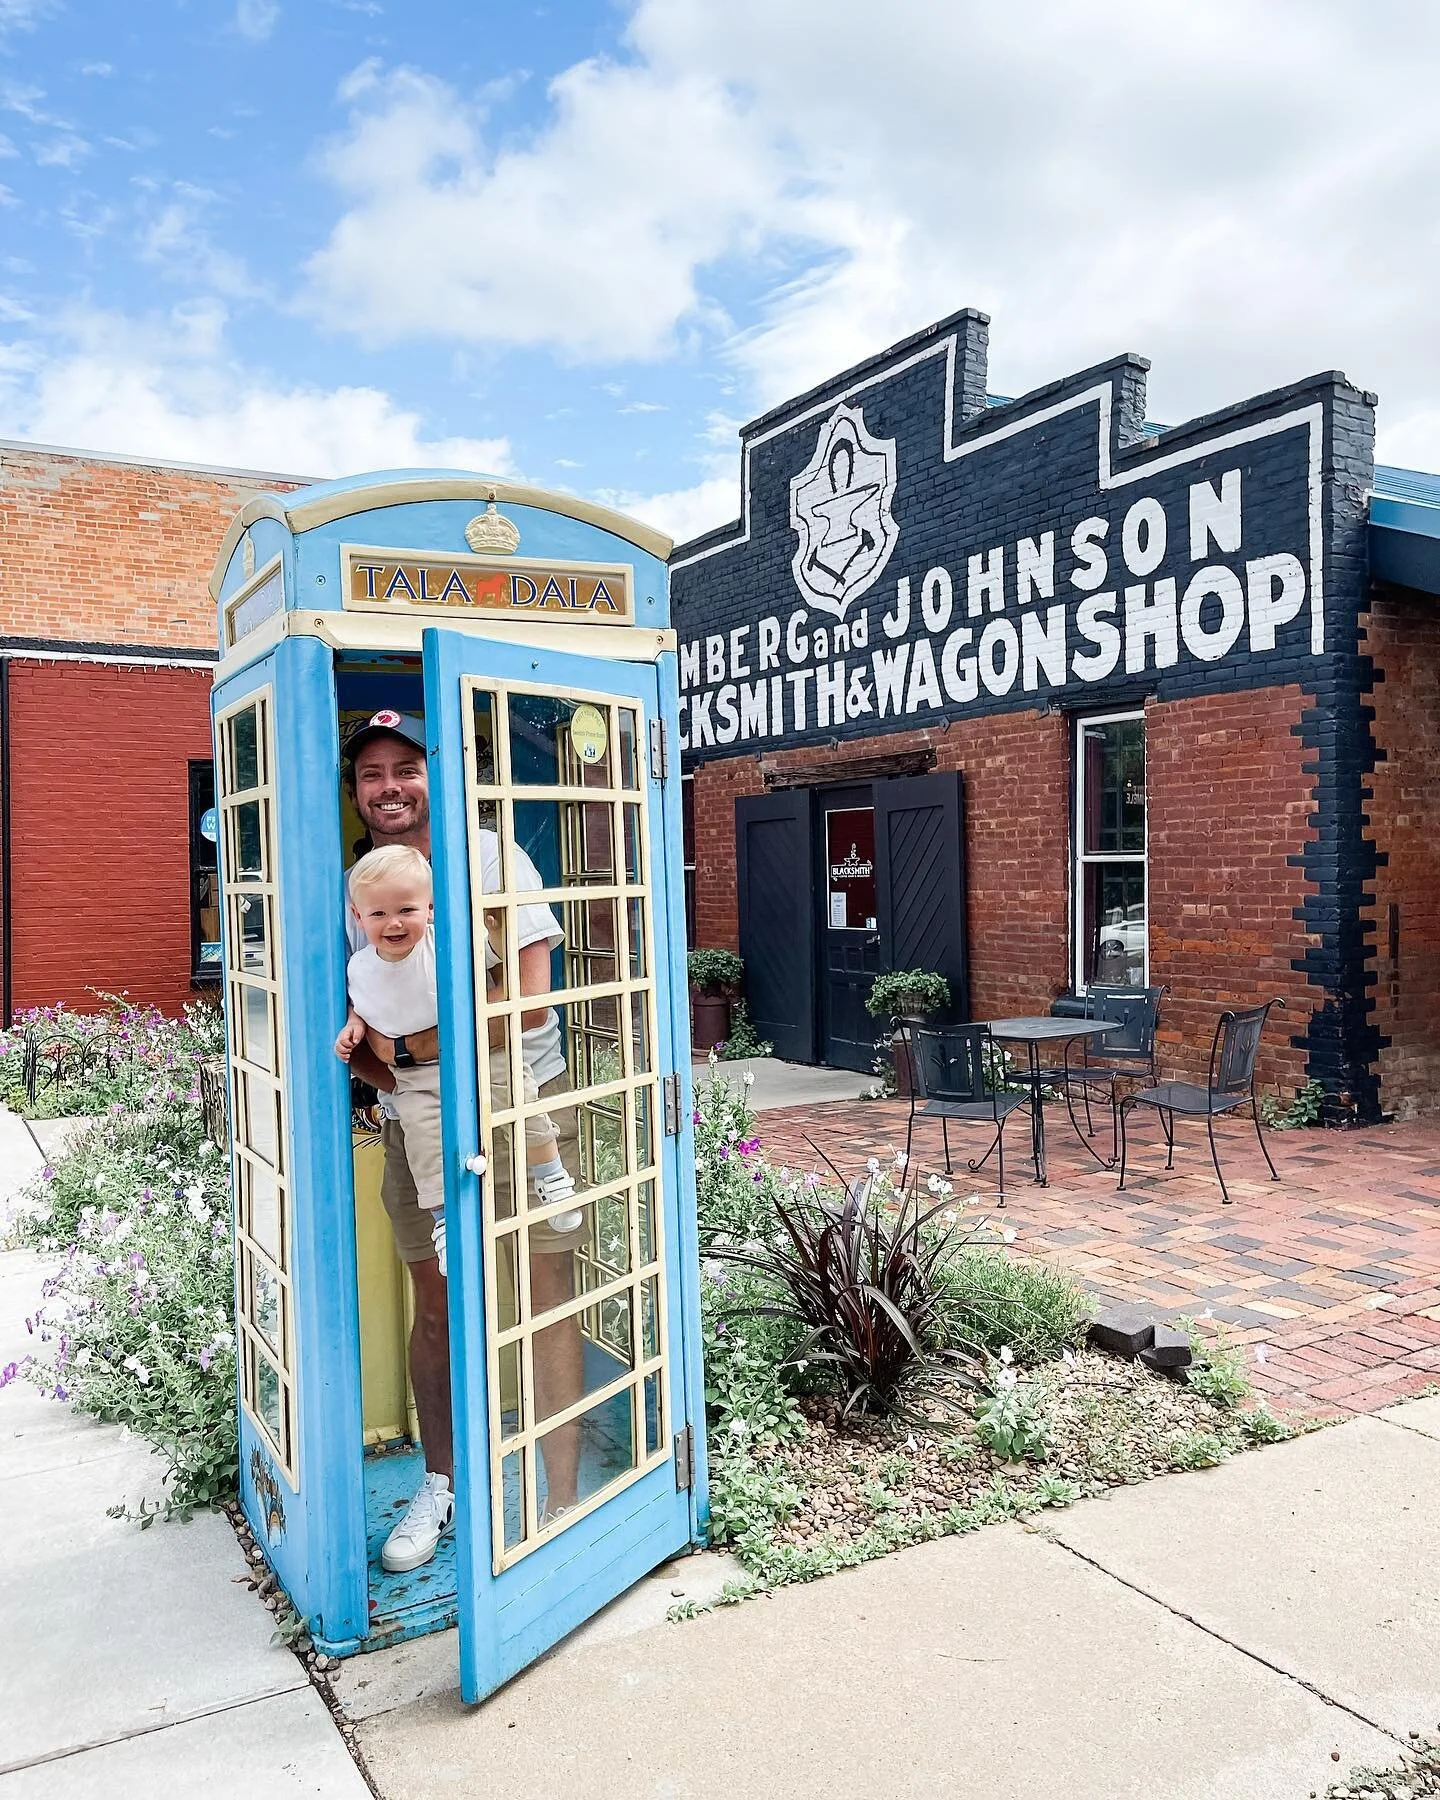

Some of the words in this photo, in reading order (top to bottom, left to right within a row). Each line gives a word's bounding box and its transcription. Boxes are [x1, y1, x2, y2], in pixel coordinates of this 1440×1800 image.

[355, 564, 475, 604] TALA
[509, 574, 619, 612] DALA
[680, 609, 809, 690] MBERG
[813, 607, 869, 660] and
[882, 468, 1244, 640] JOHNSON
[832, 866, 870, 875] BLACKSMITH
